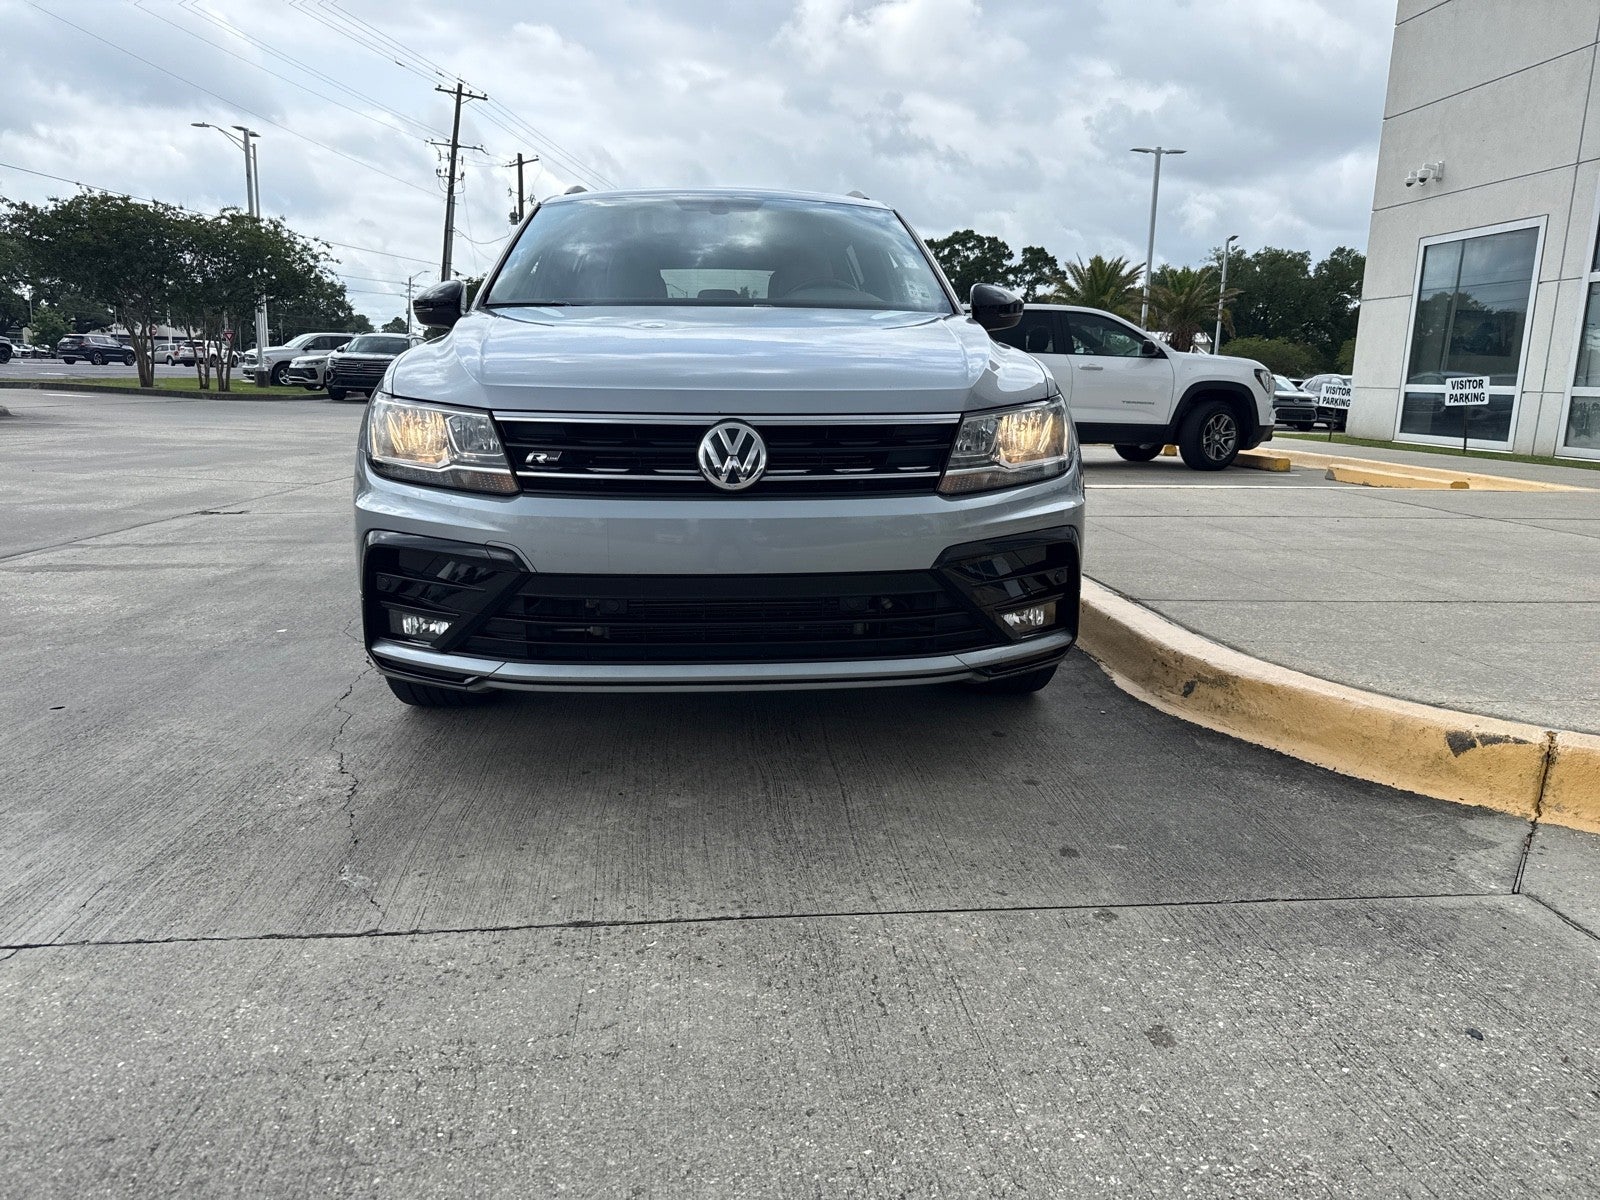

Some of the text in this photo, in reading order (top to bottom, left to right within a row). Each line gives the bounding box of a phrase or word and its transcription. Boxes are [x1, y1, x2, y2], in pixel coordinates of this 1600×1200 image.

[1451, 379, 1484, 390] VISITOR
[1326, 386, 1351, 396] VISITOR
[1322, 396, 1351, 407] PARKING
[1449, 392, 1485, 403] PARKING
[701, 424, 764, 488] VW
